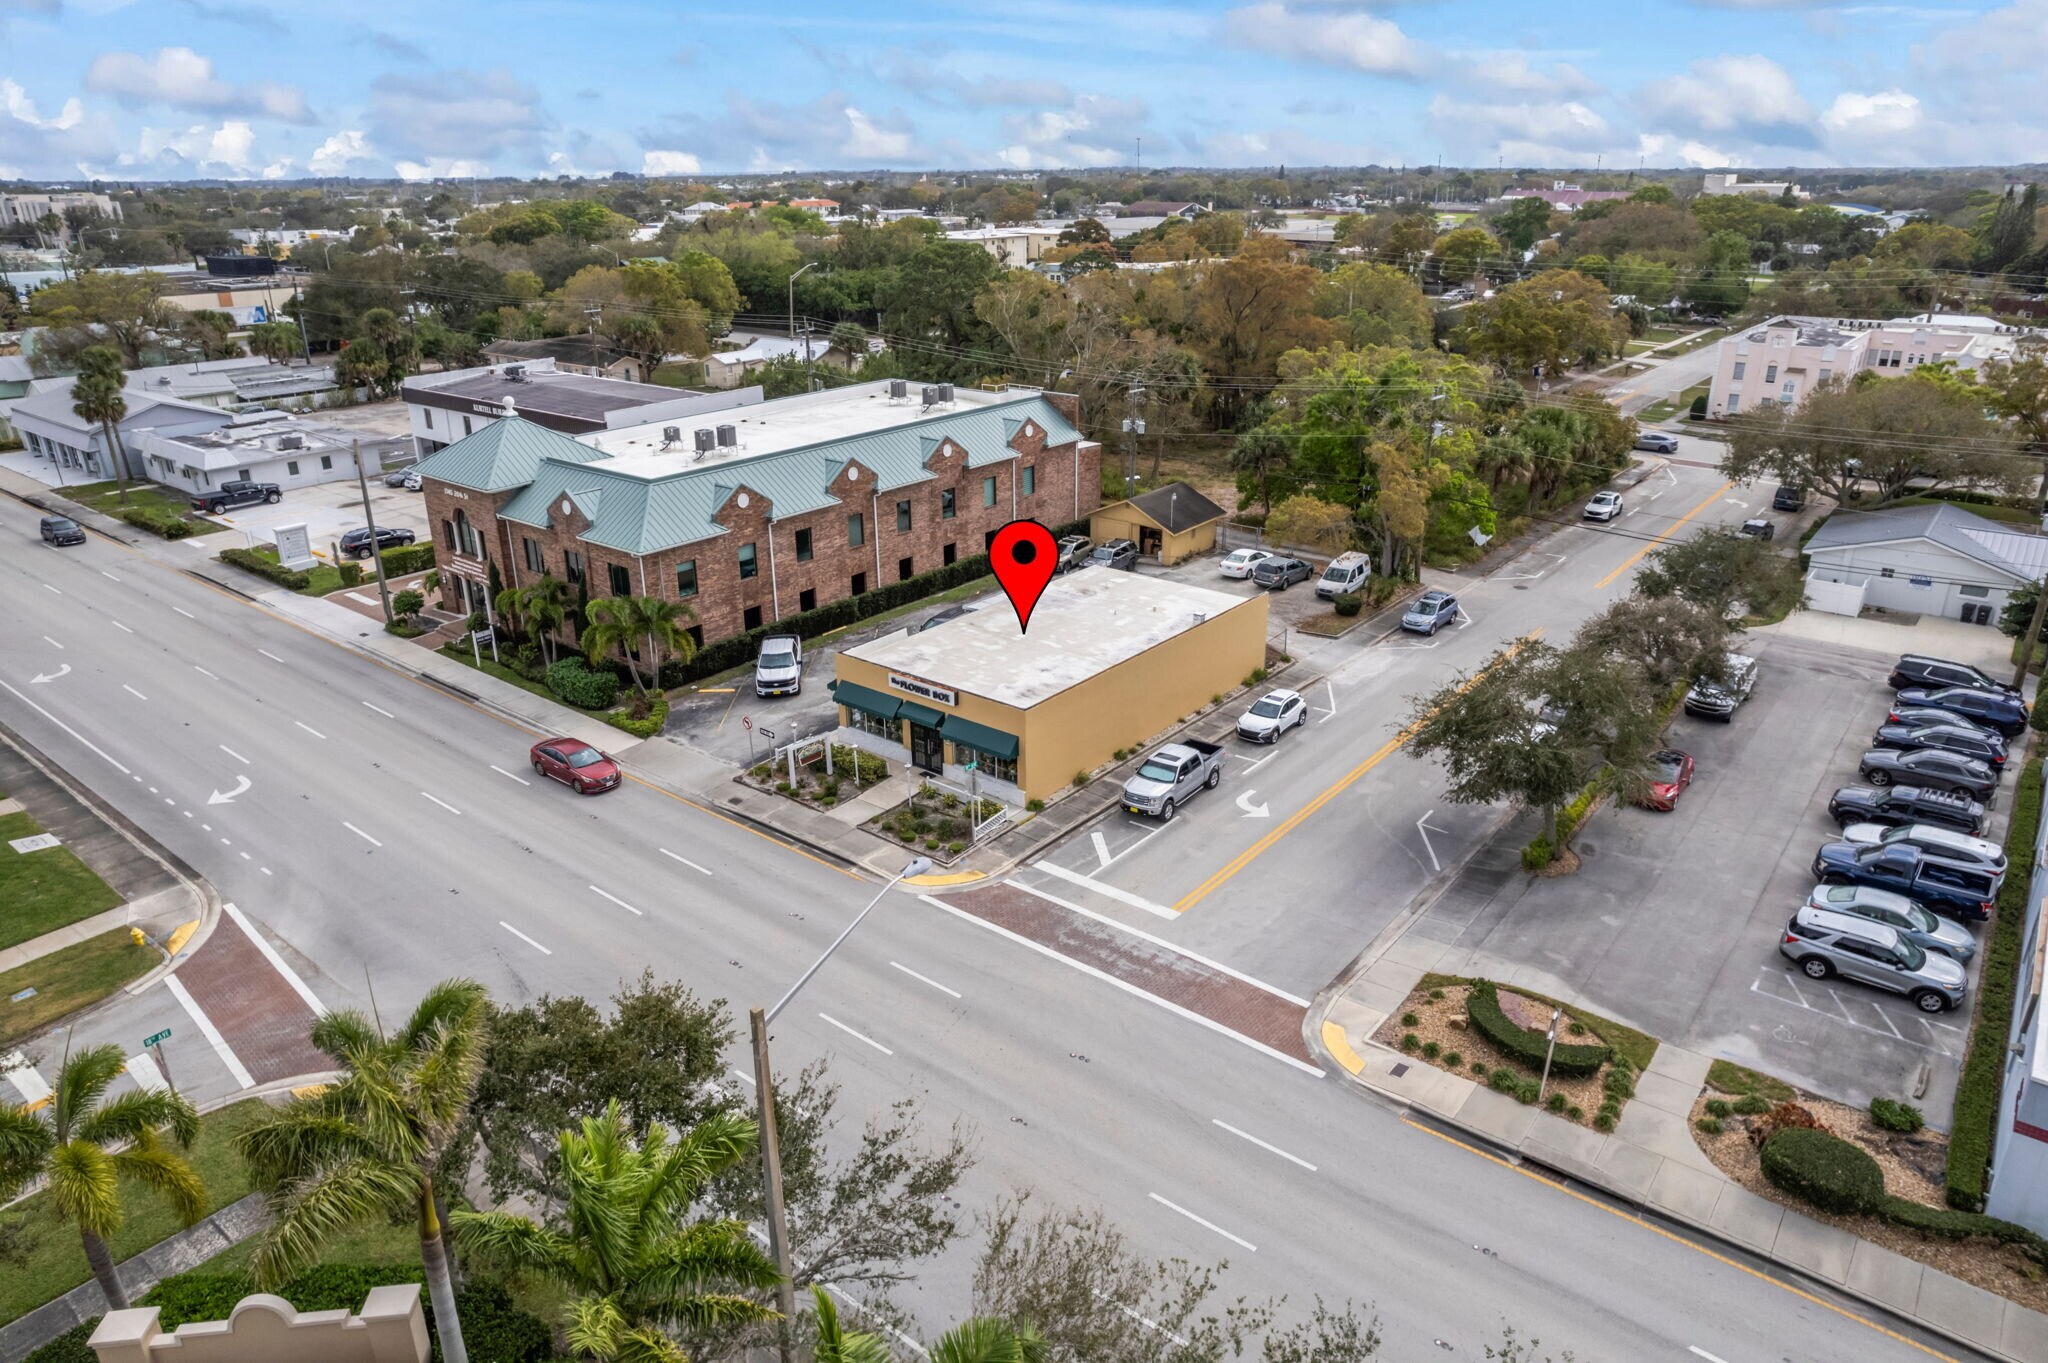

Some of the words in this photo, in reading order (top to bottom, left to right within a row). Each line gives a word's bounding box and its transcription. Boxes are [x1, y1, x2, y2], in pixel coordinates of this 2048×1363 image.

[900, 681, 931, 697] FLOWER
[932, 690, 951, 703] BOX
[158, 1030, 170, 1041] AVE
